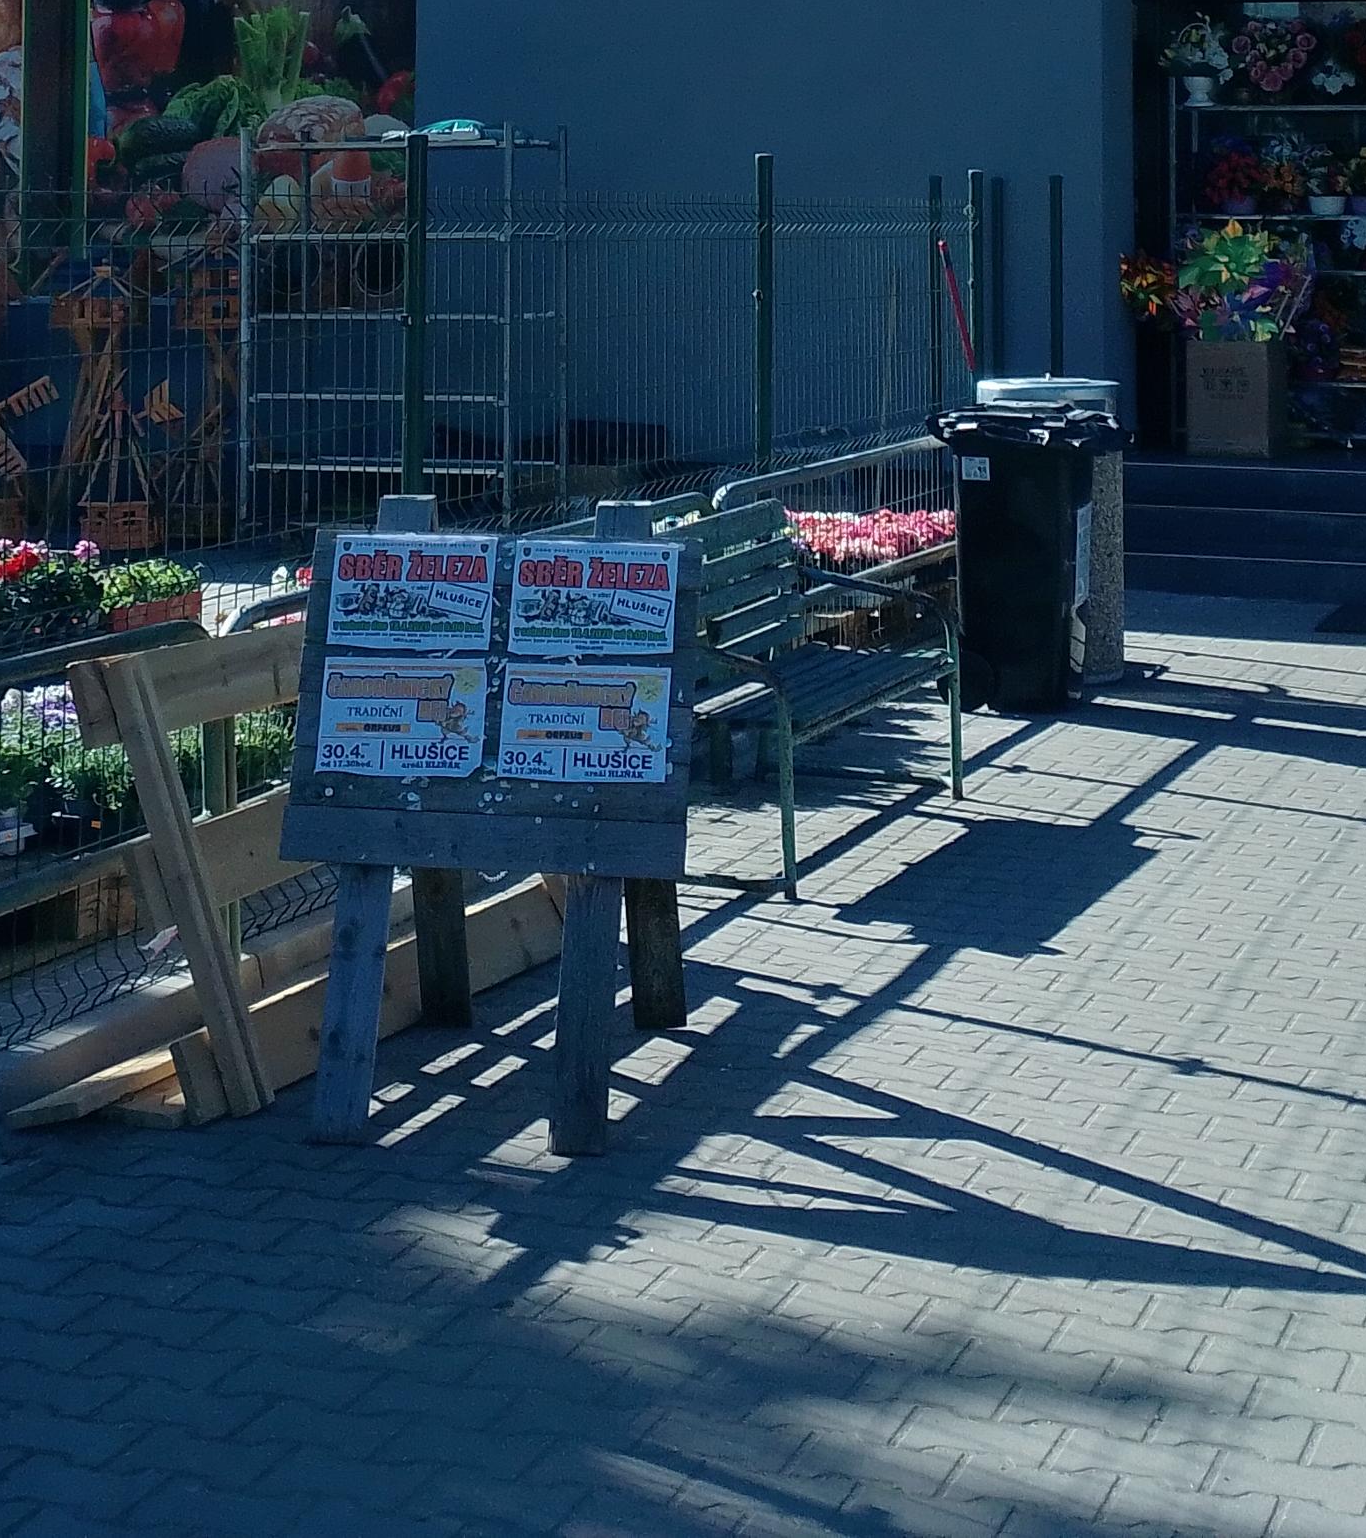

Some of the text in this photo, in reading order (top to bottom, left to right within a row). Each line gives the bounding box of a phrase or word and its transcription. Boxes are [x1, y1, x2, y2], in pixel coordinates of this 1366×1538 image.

[339, 549, 489, 584] SBĚR ŽELEZA
[519, 555, 670, 592] SBĚR ŽELEZA
[435, 589, 484, 609] HLUŠICE
[616, 597, 666, 617] HLUŠICE
[346, 705, 403, 718] TRADIČNÍ
[528, 712, 585, 726] TRADIČNÍ
[322, 743, 470, 761] 30.4. HLUŠICE
[503, 751, 653, 771] 30.4. HLUŠICE
